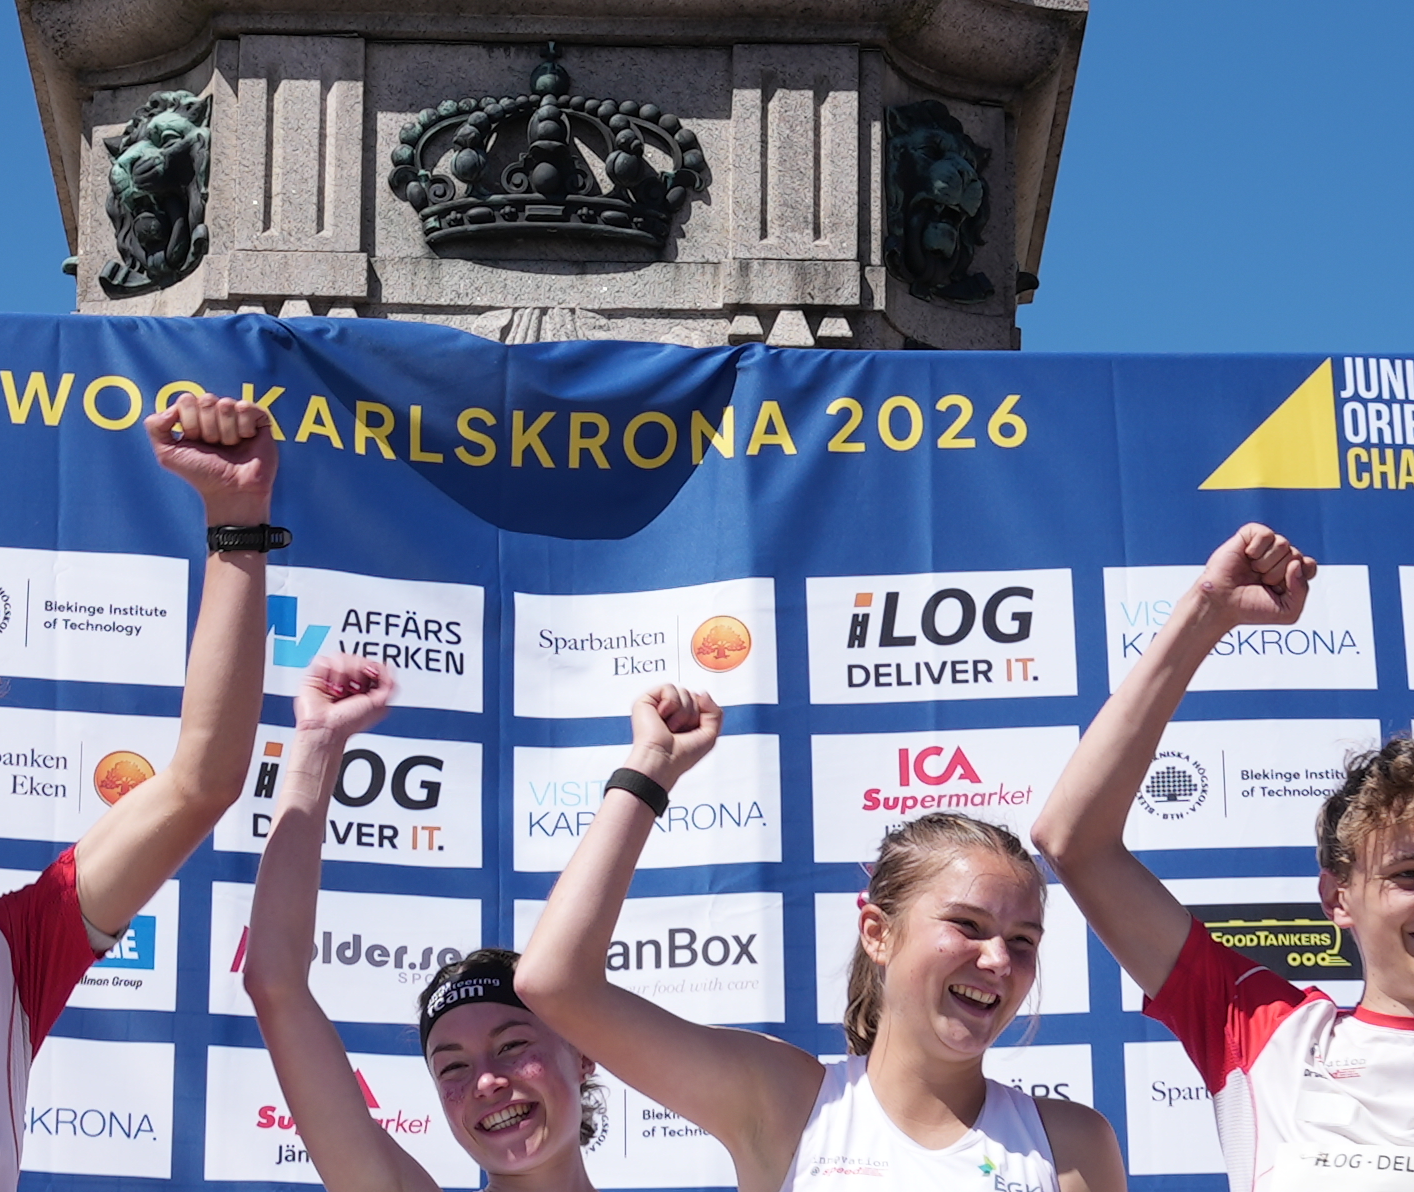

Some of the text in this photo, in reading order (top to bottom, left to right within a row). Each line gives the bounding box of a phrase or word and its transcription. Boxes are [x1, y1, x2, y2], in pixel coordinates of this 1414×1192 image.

[241, 383, 798, 470] KARLSKRONA
[825, 393, 1029, 453] 2026
[44, 600, 168, 617] Blekinge Institute
[846, 586, 1035, 649] iLOG
[1120, 600, 1171, 629] VIS
[43, 618, 142, 636] of Technology
[339, 606, 462, 646] AFFÄRS
[538, 626, 666, 655] Sparbanken
[338, 640, 465, 676] VERKEN
[612, 654, 667, 678] Eken
[846, 657, 1039, 688] DELIVER IT.
[898, 744, 982, 787] ICA
[1240, 769, 1300, 782] Blekinge
[10, 774, 68, 799] Eken
[861, 783, 1034, 817] Supermarket
[1241, 786, 1255, 797] of
[411, 824, 445, 852] IT.
[606, 927, 759, 972] anBox
[112, 976, 144, 990] Group
[652, 978, 760, 997] food with care
[642, 1126, 656, 1138] of
